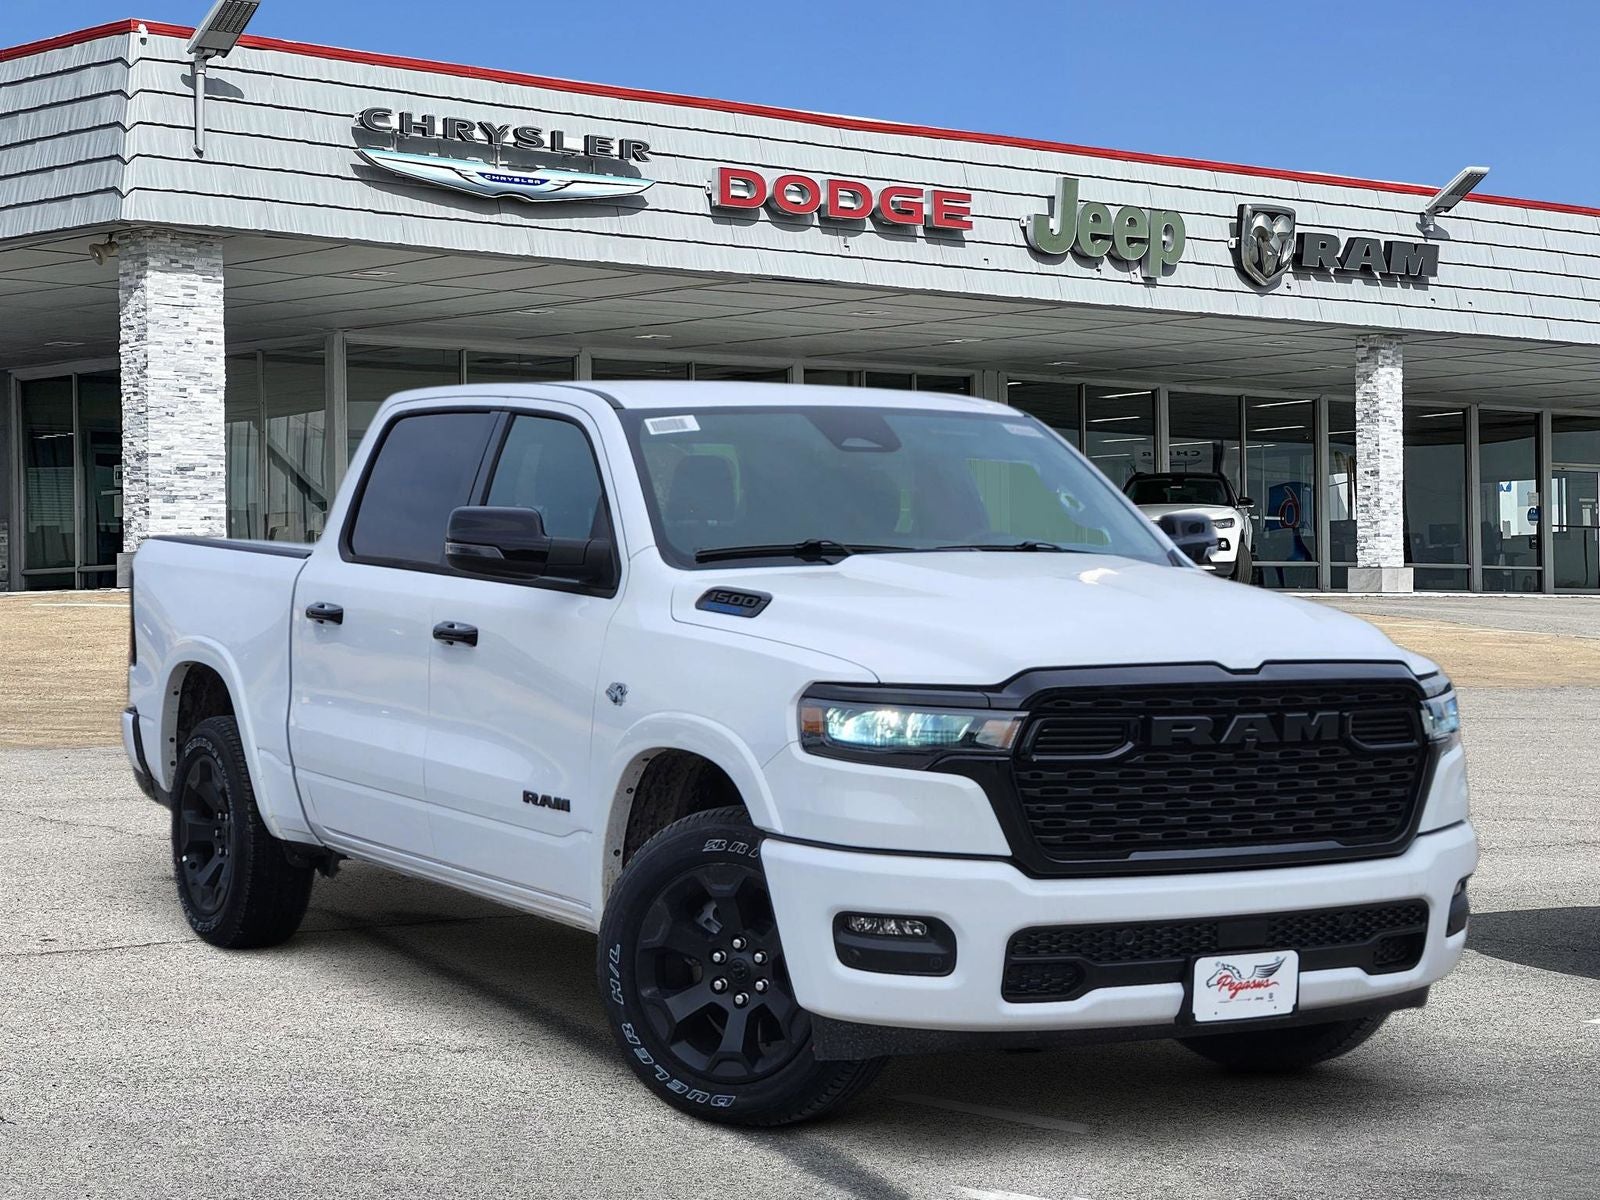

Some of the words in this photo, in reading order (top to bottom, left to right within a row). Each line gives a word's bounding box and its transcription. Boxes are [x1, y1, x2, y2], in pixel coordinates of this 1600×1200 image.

[358, 107, 652, 162] CHRYSLER
[484, 174, 541, 184] CHRYSLER
[712, 167, 973, 230] DODGE
[1028, 177, 1186, 278] Jeep
[1298, 232, 1440, 277] RAM
[709, 590, 759, 607] 1500
[1152, 711, 1340, 746] RAM
[522, 790, 571, 812] RAM
[1216, 974, 1277, 999] Pegasus
[621, 1022, 736, 1107] DUELER
